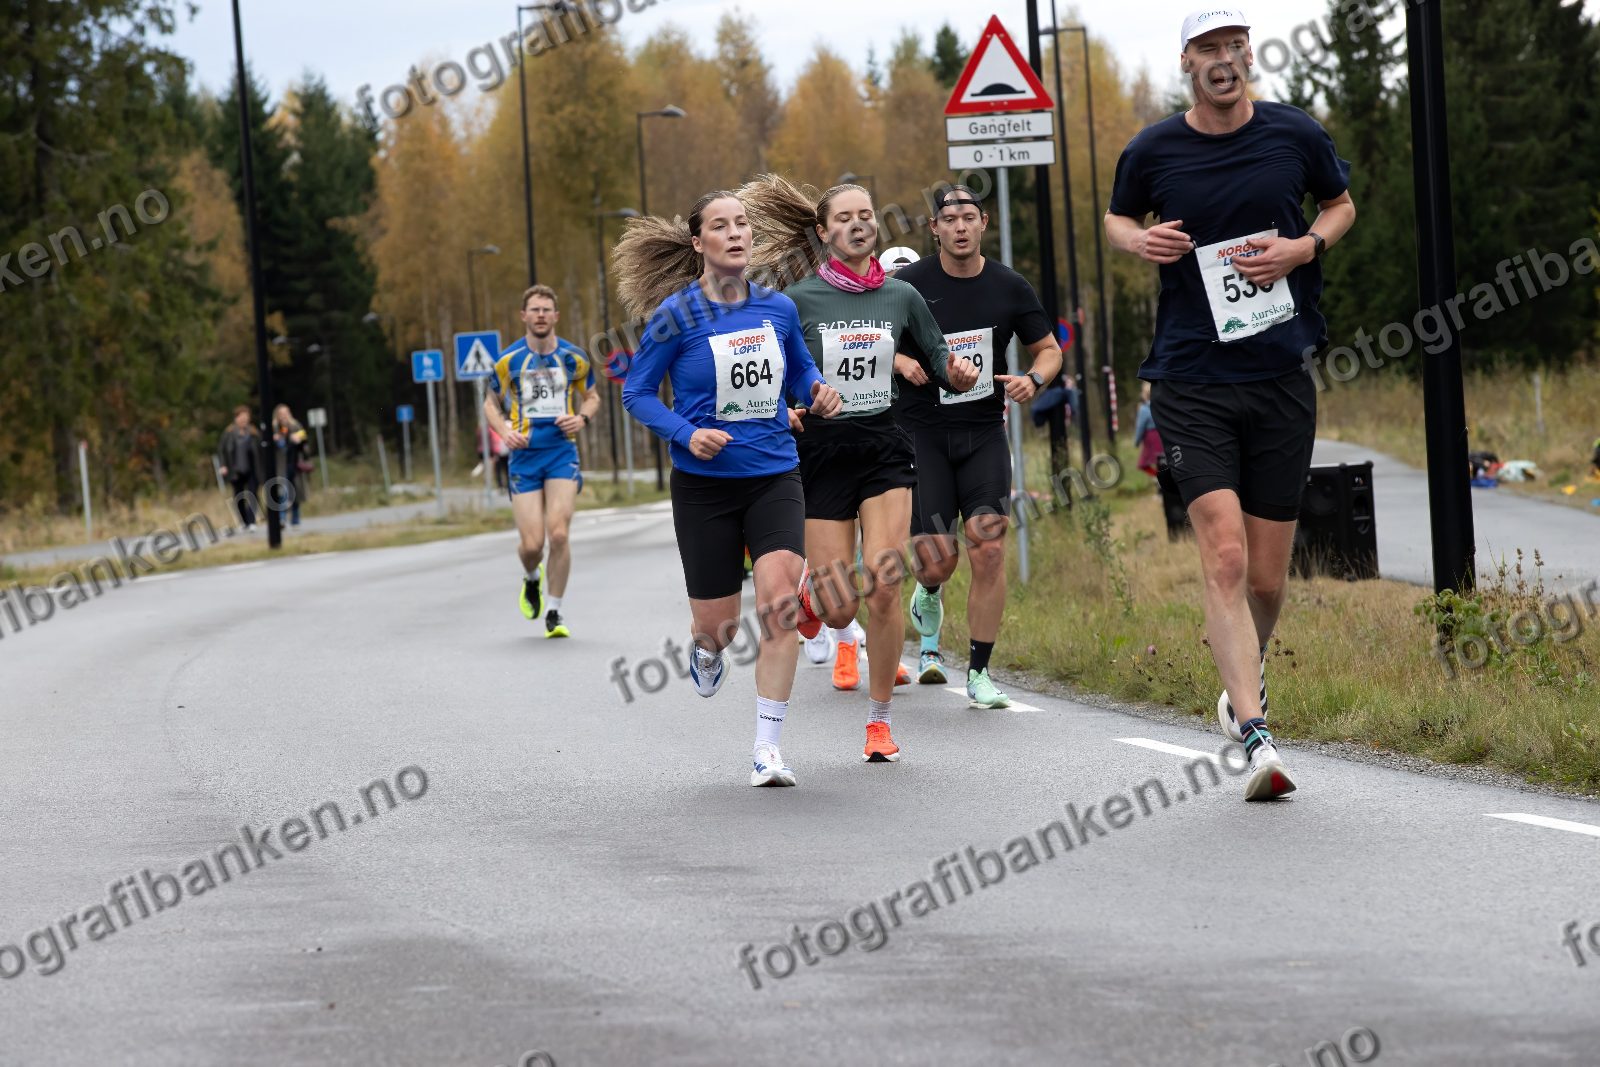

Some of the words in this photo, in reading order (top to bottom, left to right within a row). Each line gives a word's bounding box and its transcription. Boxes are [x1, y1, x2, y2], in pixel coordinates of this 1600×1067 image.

[968, 119, 1032, 136] Gangfelt
[973, 150, 983, 163] 0
[999, 149, 1004, 161] 1
[1008, 147, 1030, 161] km
[1251, 302, 1292, 321] Aurskog
[728, 335, 766, 348] NORGES
[839, 333, 881, 343] NORGES
[948, 334, 983, 346] NORGES
[733, 343, 762, 355] LØPET
[842, 341, 876, 351] LØPET
[730, 358, 773, 390] 664
[837, 355, 877, 381] 451
[532, 385, 556, 400] 561
[852, 389, 889, 401] Aurskog
